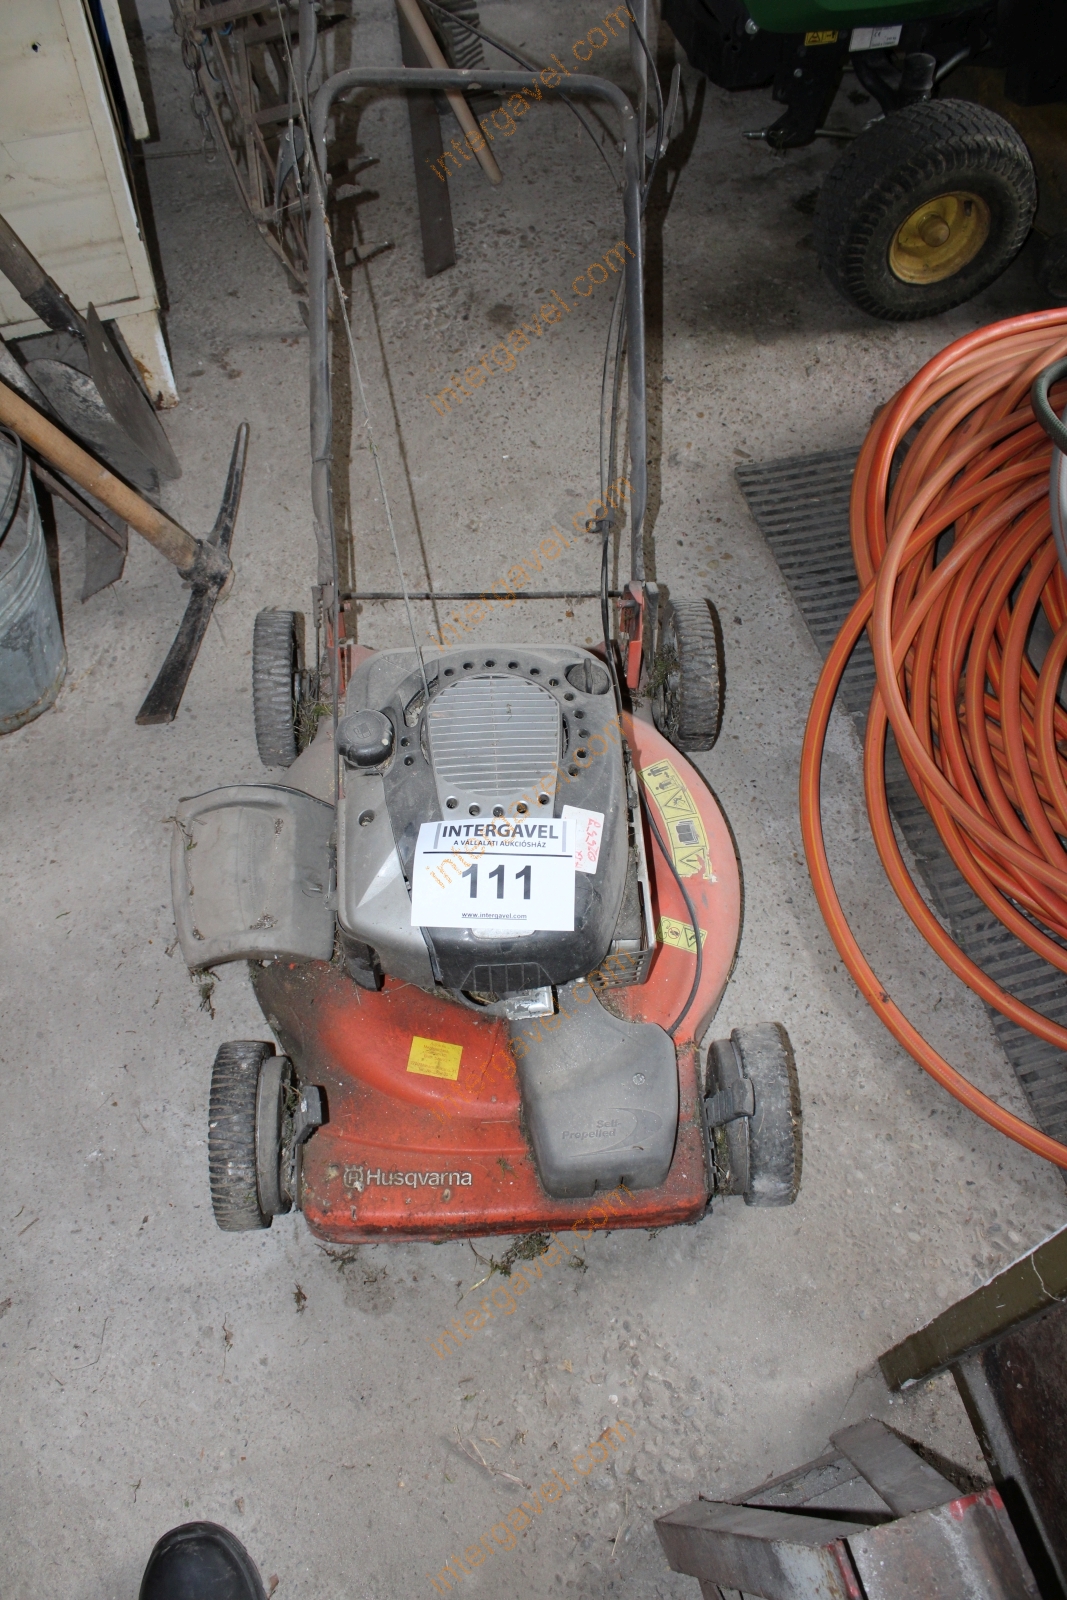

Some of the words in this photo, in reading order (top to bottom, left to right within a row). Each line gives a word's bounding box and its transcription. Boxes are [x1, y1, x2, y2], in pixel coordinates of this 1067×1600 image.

[442, 824, 559, 840] INTERGAVEL
[461, 839, 498, 847] VÁLLALATI
[462, 863, 532, 900] 111
[461, 912, 527, 920] www.intergavel.com
[562, 1128, 616, 1140] Propelled
[366, 1168, 472, 1188] Husqvarna
